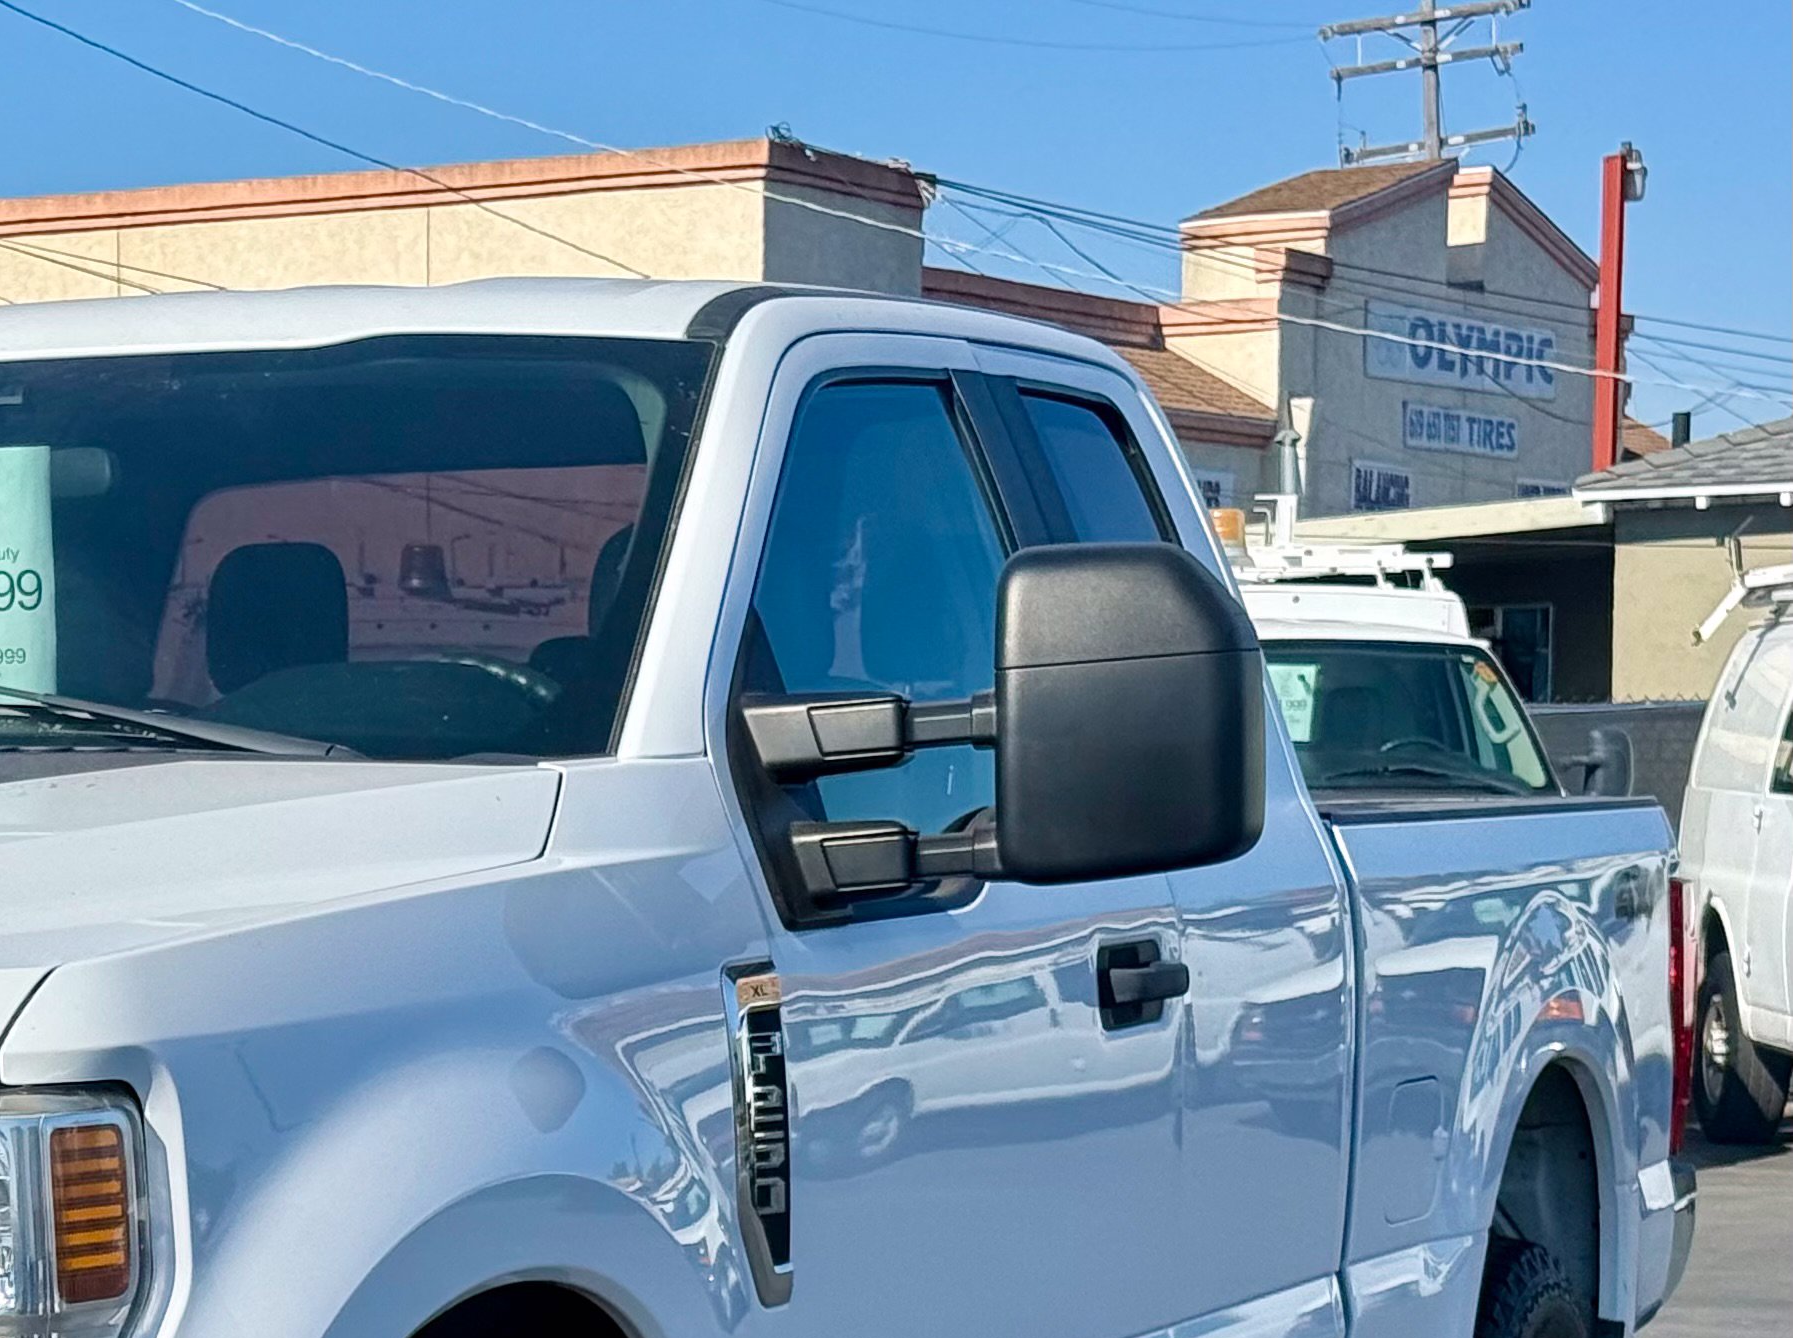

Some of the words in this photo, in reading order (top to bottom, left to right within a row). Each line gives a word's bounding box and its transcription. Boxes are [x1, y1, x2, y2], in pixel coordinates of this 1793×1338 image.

[1408, 316, 1554, 385] OLYMPIC
[1465, 416, 1517, 452] TIRES
[749, 983, 769, 998] XL
